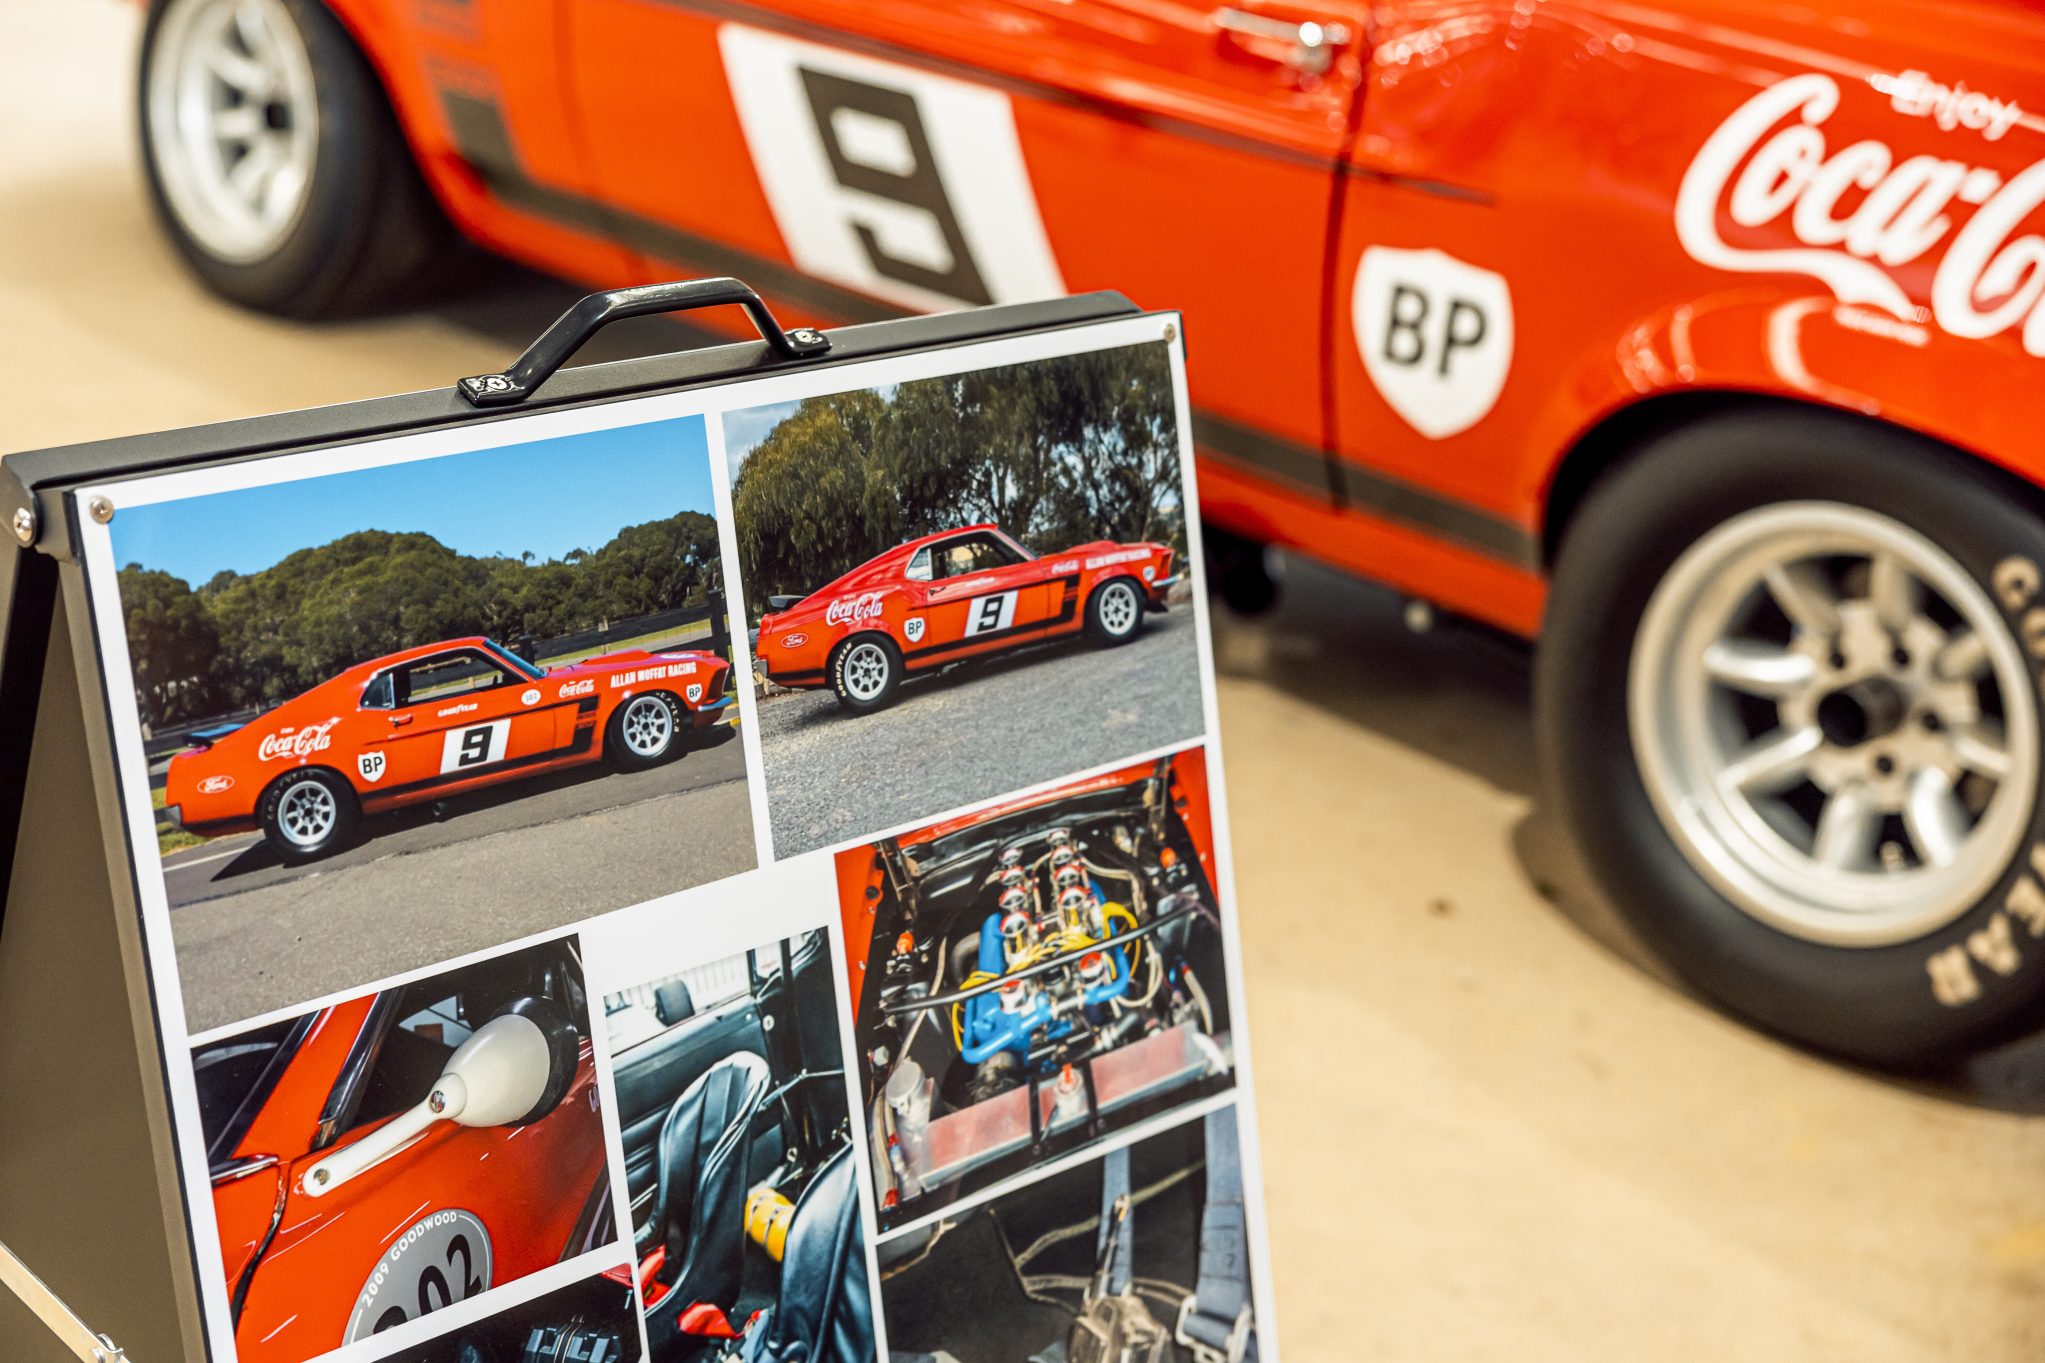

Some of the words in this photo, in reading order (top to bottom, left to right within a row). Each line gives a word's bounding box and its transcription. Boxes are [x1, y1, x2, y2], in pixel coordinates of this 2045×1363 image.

[799, 64, 998, 307] 9
[1673, 72, 2045, 358] Coca-C
[1381, 284, 1489, 377] BP
[826, 591, 885, 626] Coca-Cola
[908, 620, 922, 635] BP
[977, 595, 1005, 633] 9
[610, 672, 636, 689] ALLAN
[637, 666, 667, 682] MOFFAT
[668, 662, 697, 677] RACING
[835, 642, 853, 698] GOODYEAR
[688, 686, 701, 698] BP
[259, 720, 335, 761] Coca-Cola
[458, 725, 494, 767] 9
[362, 756, 384, 774] BP
[361, 1262, 390, 1308] 2009
[390, 1211, 457, 1261] GOODWOOD
